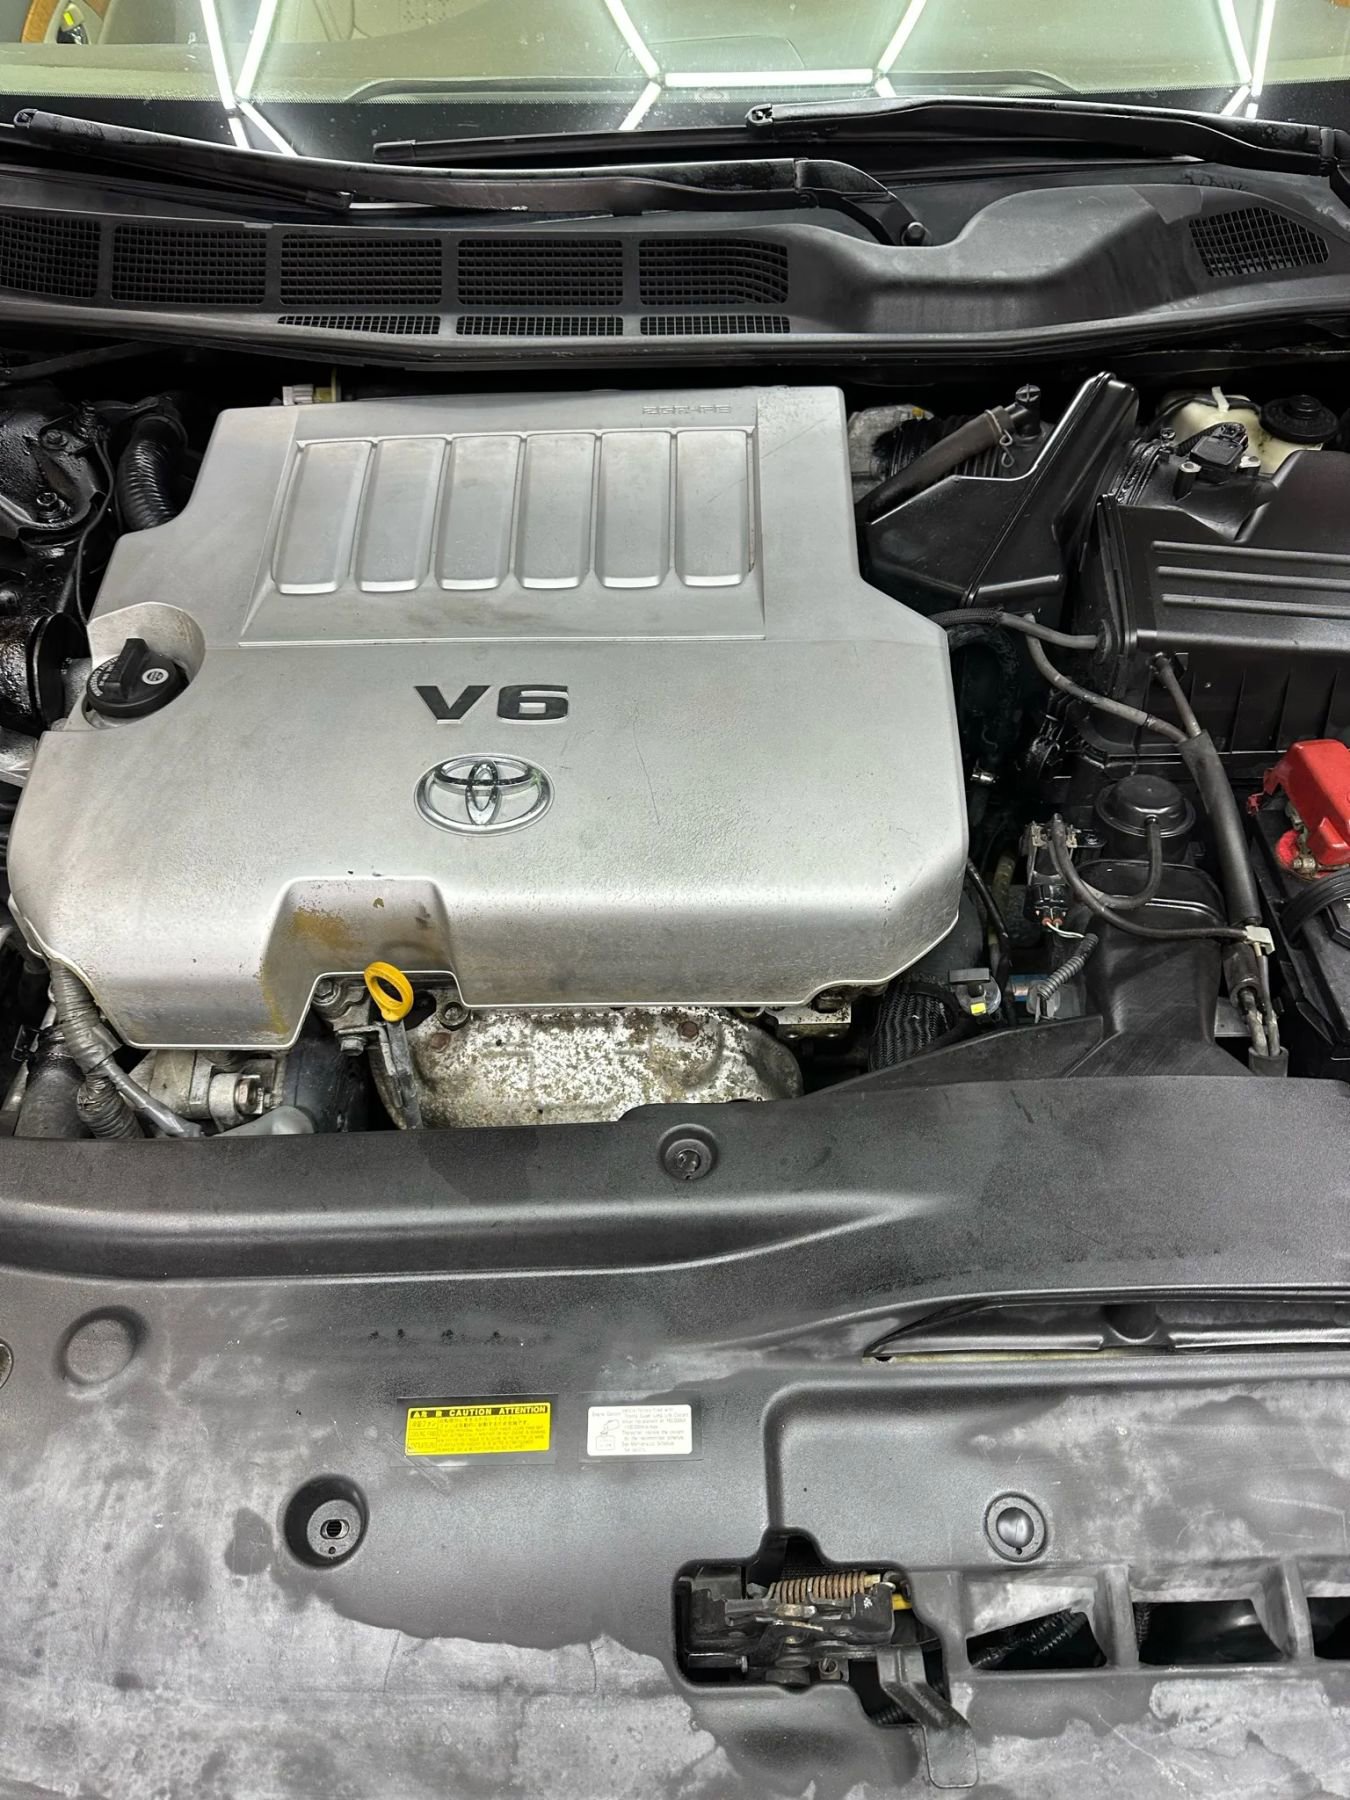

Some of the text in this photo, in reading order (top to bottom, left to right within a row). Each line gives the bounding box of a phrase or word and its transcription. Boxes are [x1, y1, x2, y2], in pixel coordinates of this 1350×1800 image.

[413, 684, 569, 724] V6
[449, 1408, 492, 1417] CAUTION
[498, 1405, 546, 1415] ATTENTION
